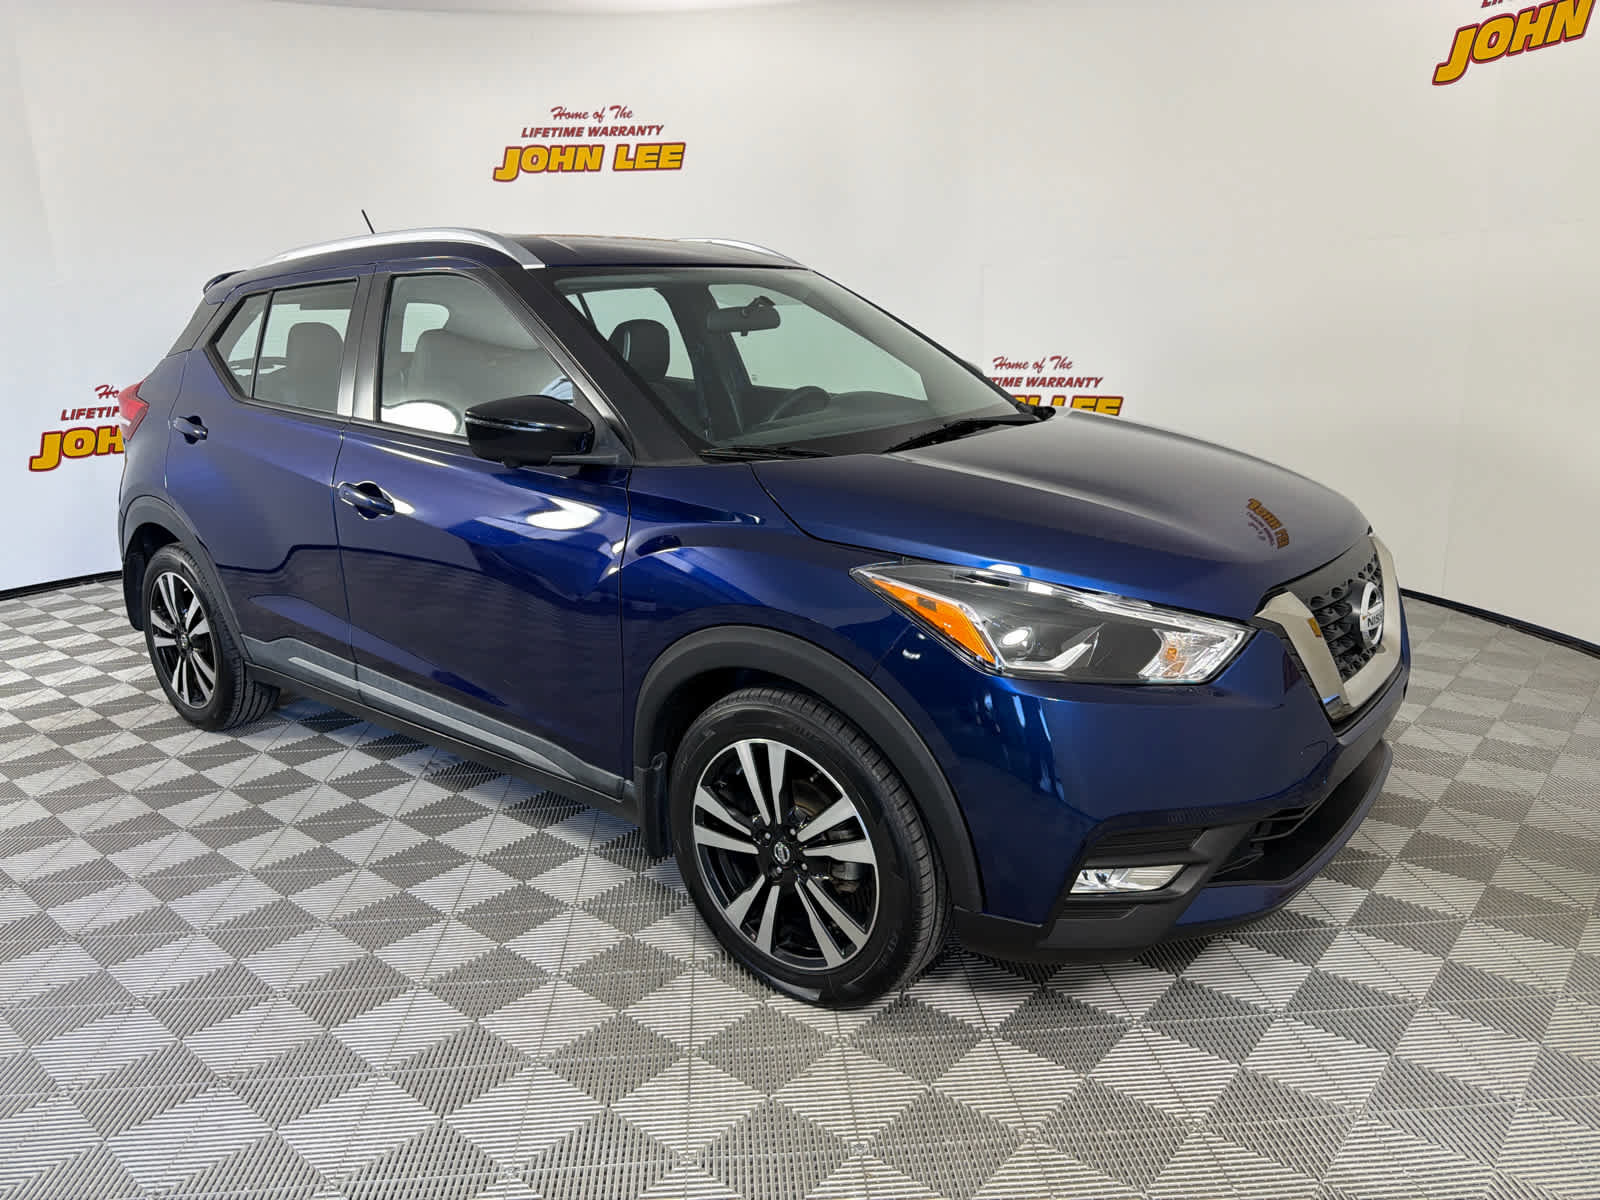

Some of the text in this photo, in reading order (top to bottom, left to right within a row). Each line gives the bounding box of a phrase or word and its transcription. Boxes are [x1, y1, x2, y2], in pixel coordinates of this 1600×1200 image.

[1432, 0, 1596, 86] JOHN
[550, 105, 633, 123] Home of The
[521, 125, 664, 138] LIFETIME WARRANTY
[493, 142, 686, 182] JOHN LEE
[992, 355, 1073, 374] Home of The
[1025, 376, 1103, 388] WARRANTY
[28, 425, 125, 472] JOH
